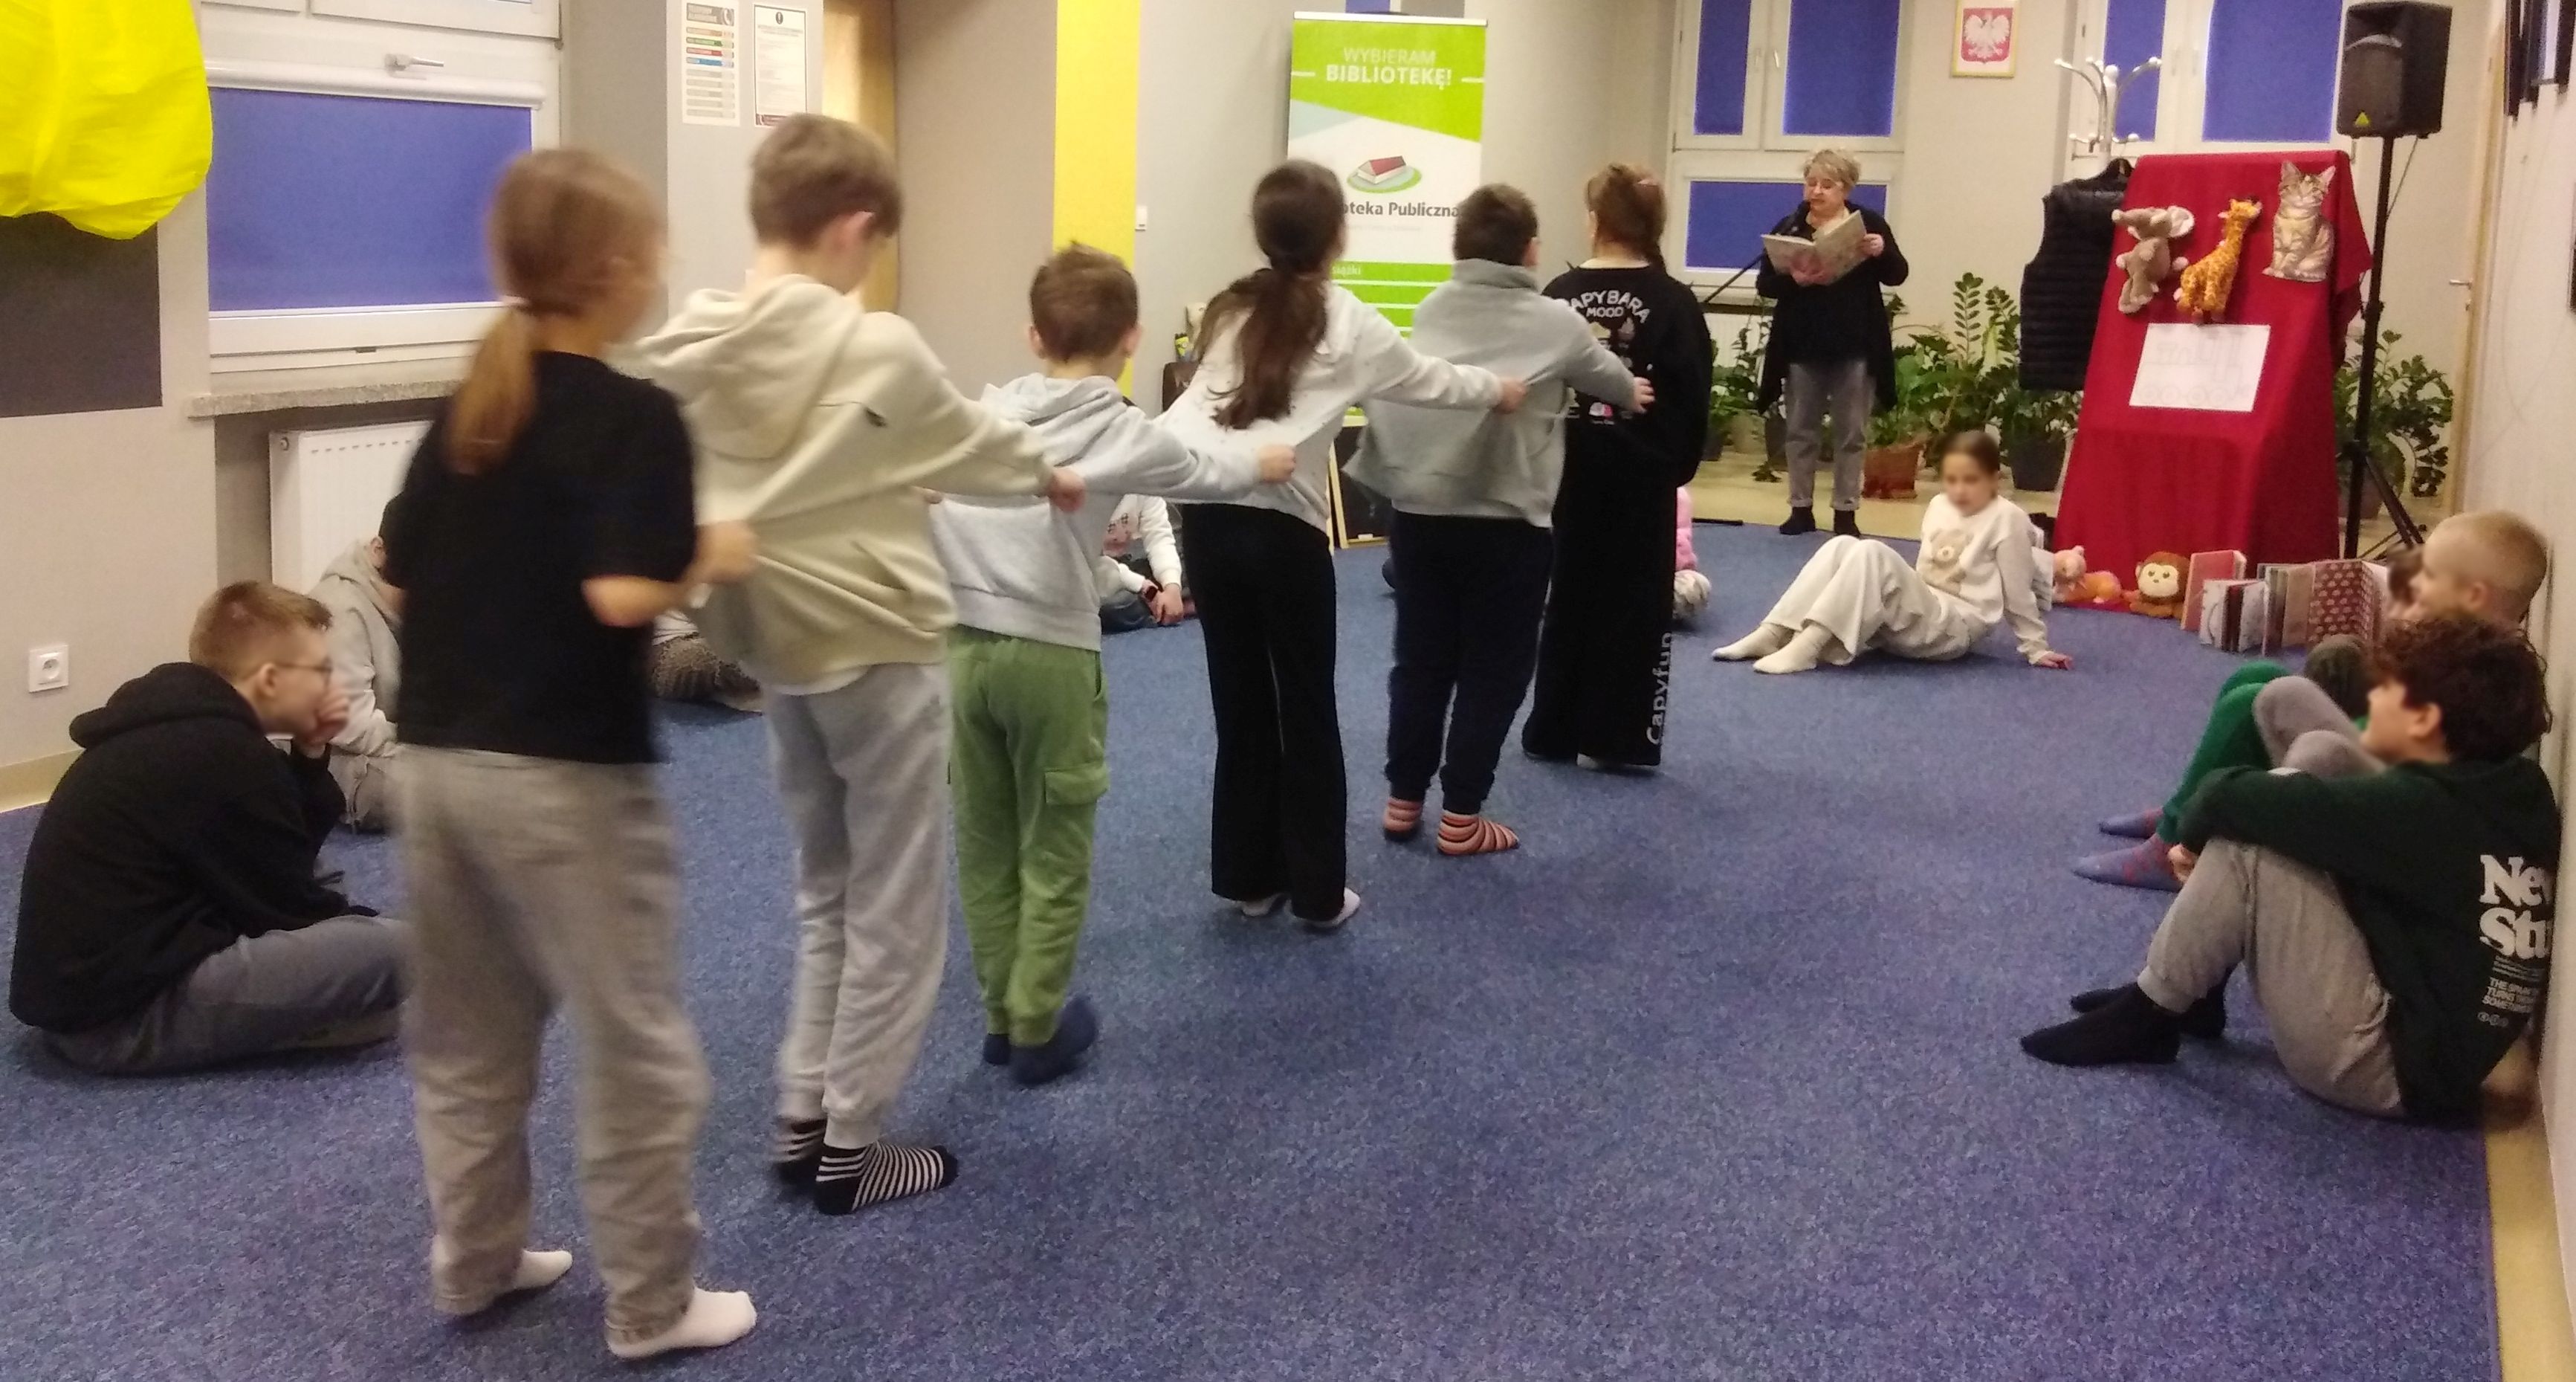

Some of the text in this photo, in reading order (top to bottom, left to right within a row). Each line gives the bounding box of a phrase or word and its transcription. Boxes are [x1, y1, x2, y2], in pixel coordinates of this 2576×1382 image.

[1344, 48, 1436, 66] WYBIERAM
[1326, 64, 1452, 90] BIBLIOTEKĘ!
[1388, 201, 1460, 217] Publiczna
[1586, 306, 1625, 317] MOOD
[1645, 632, 1672, 746] Capyfun
[2489, 977, 2508, 990] THE
